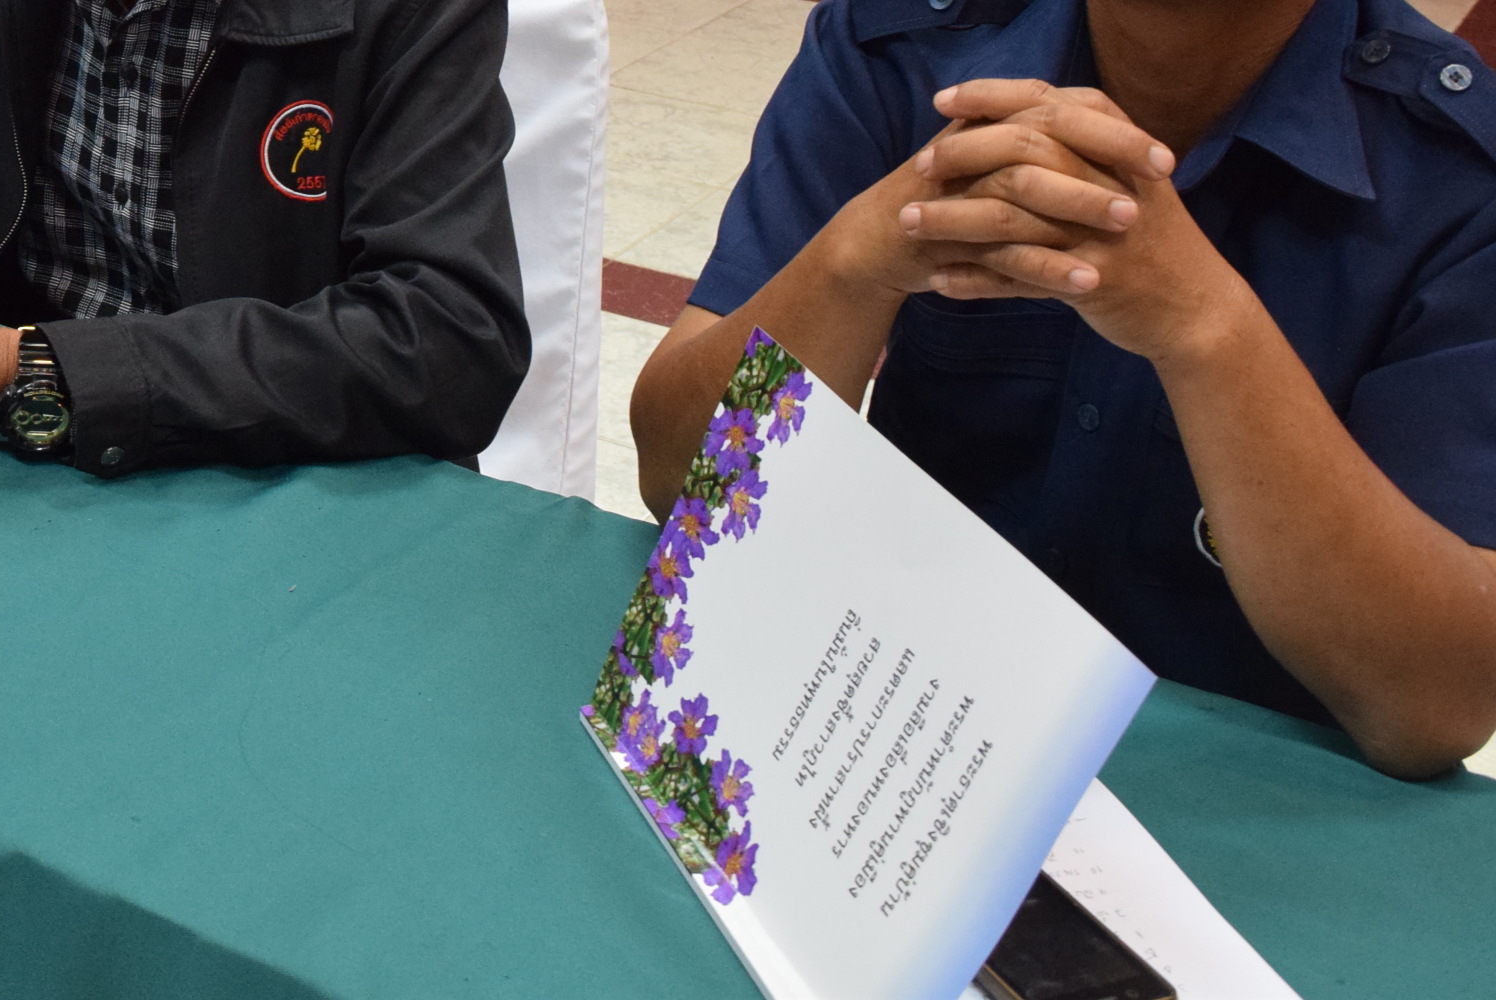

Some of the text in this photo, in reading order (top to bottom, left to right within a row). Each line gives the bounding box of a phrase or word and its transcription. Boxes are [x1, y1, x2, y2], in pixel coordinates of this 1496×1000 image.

[772, 609, 862, 762] ถิ่นมั่นในพุทธธรรม
[795, 638, 881, 787] สวยสุดซึ้งสาวภูไท
[809, 648, 916, 832] แลตระการปราสาทผึ้ง
[832, 679, 940, 859] งามลือเลื่องหนองหาร
[849, 696, 975, 899] พระตำหนักภูพานคู่เมือง
[881, 740, 993, 918] พระธาตุเชิงชุมคู่บ้าน
